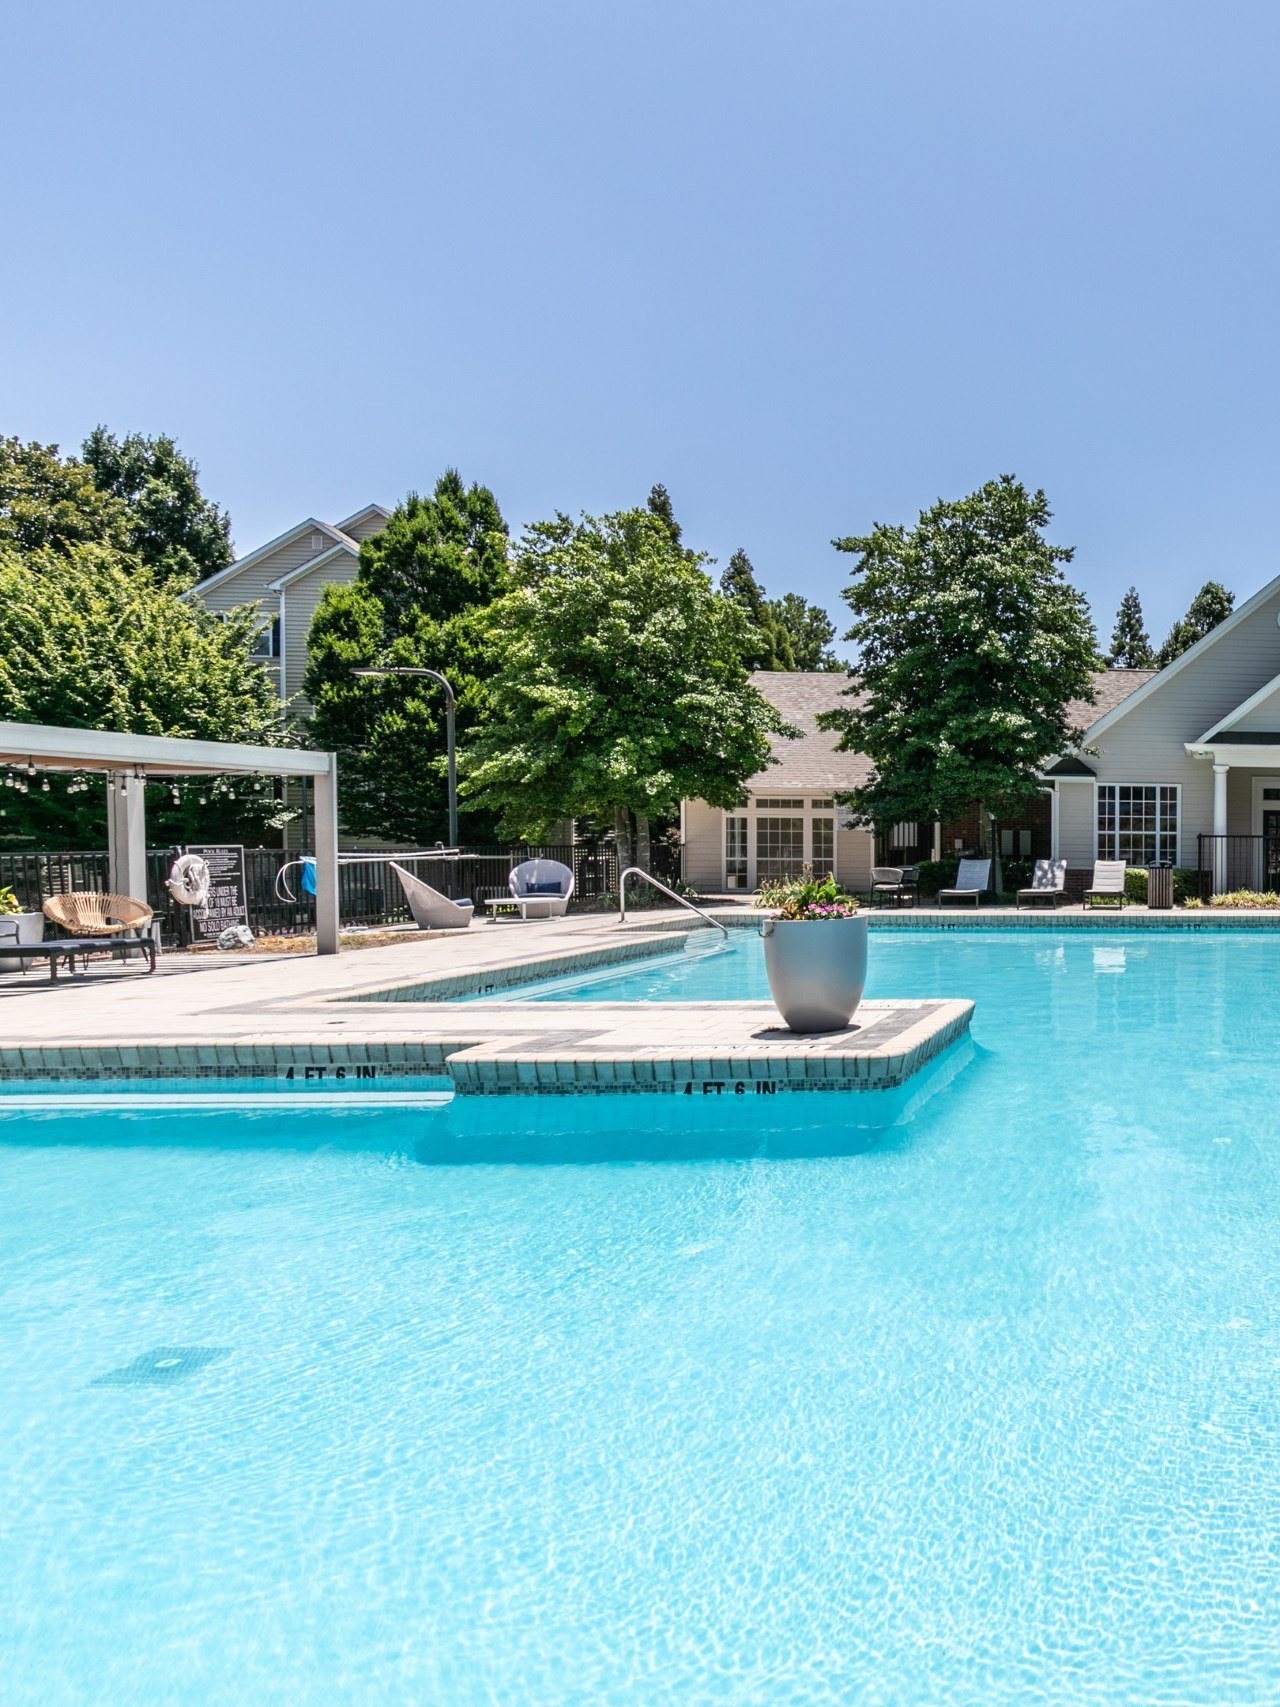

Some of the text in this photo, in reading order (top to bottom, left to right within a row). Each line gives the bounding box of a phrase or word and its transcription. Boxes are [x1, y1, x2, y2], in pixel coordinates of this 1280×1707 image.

[216, 886, 230, 896] UNDER
[230, 885, 238, 896] THE
[220, 897, 231, 907] MUST
[231, 896, 237, 906] BE
[221, 907, 226, 917] BY
[226, 907, 232, 916] AN
[232, 906, 246, 916] ADULT
[199, 922, 207, 933] NO
[208, 921, 220, 932] SOLO
[285, 1065, 376, 1080] 4 FT 6 IN
[683, 1080, 776, 1095] 4 FT 6 IN
